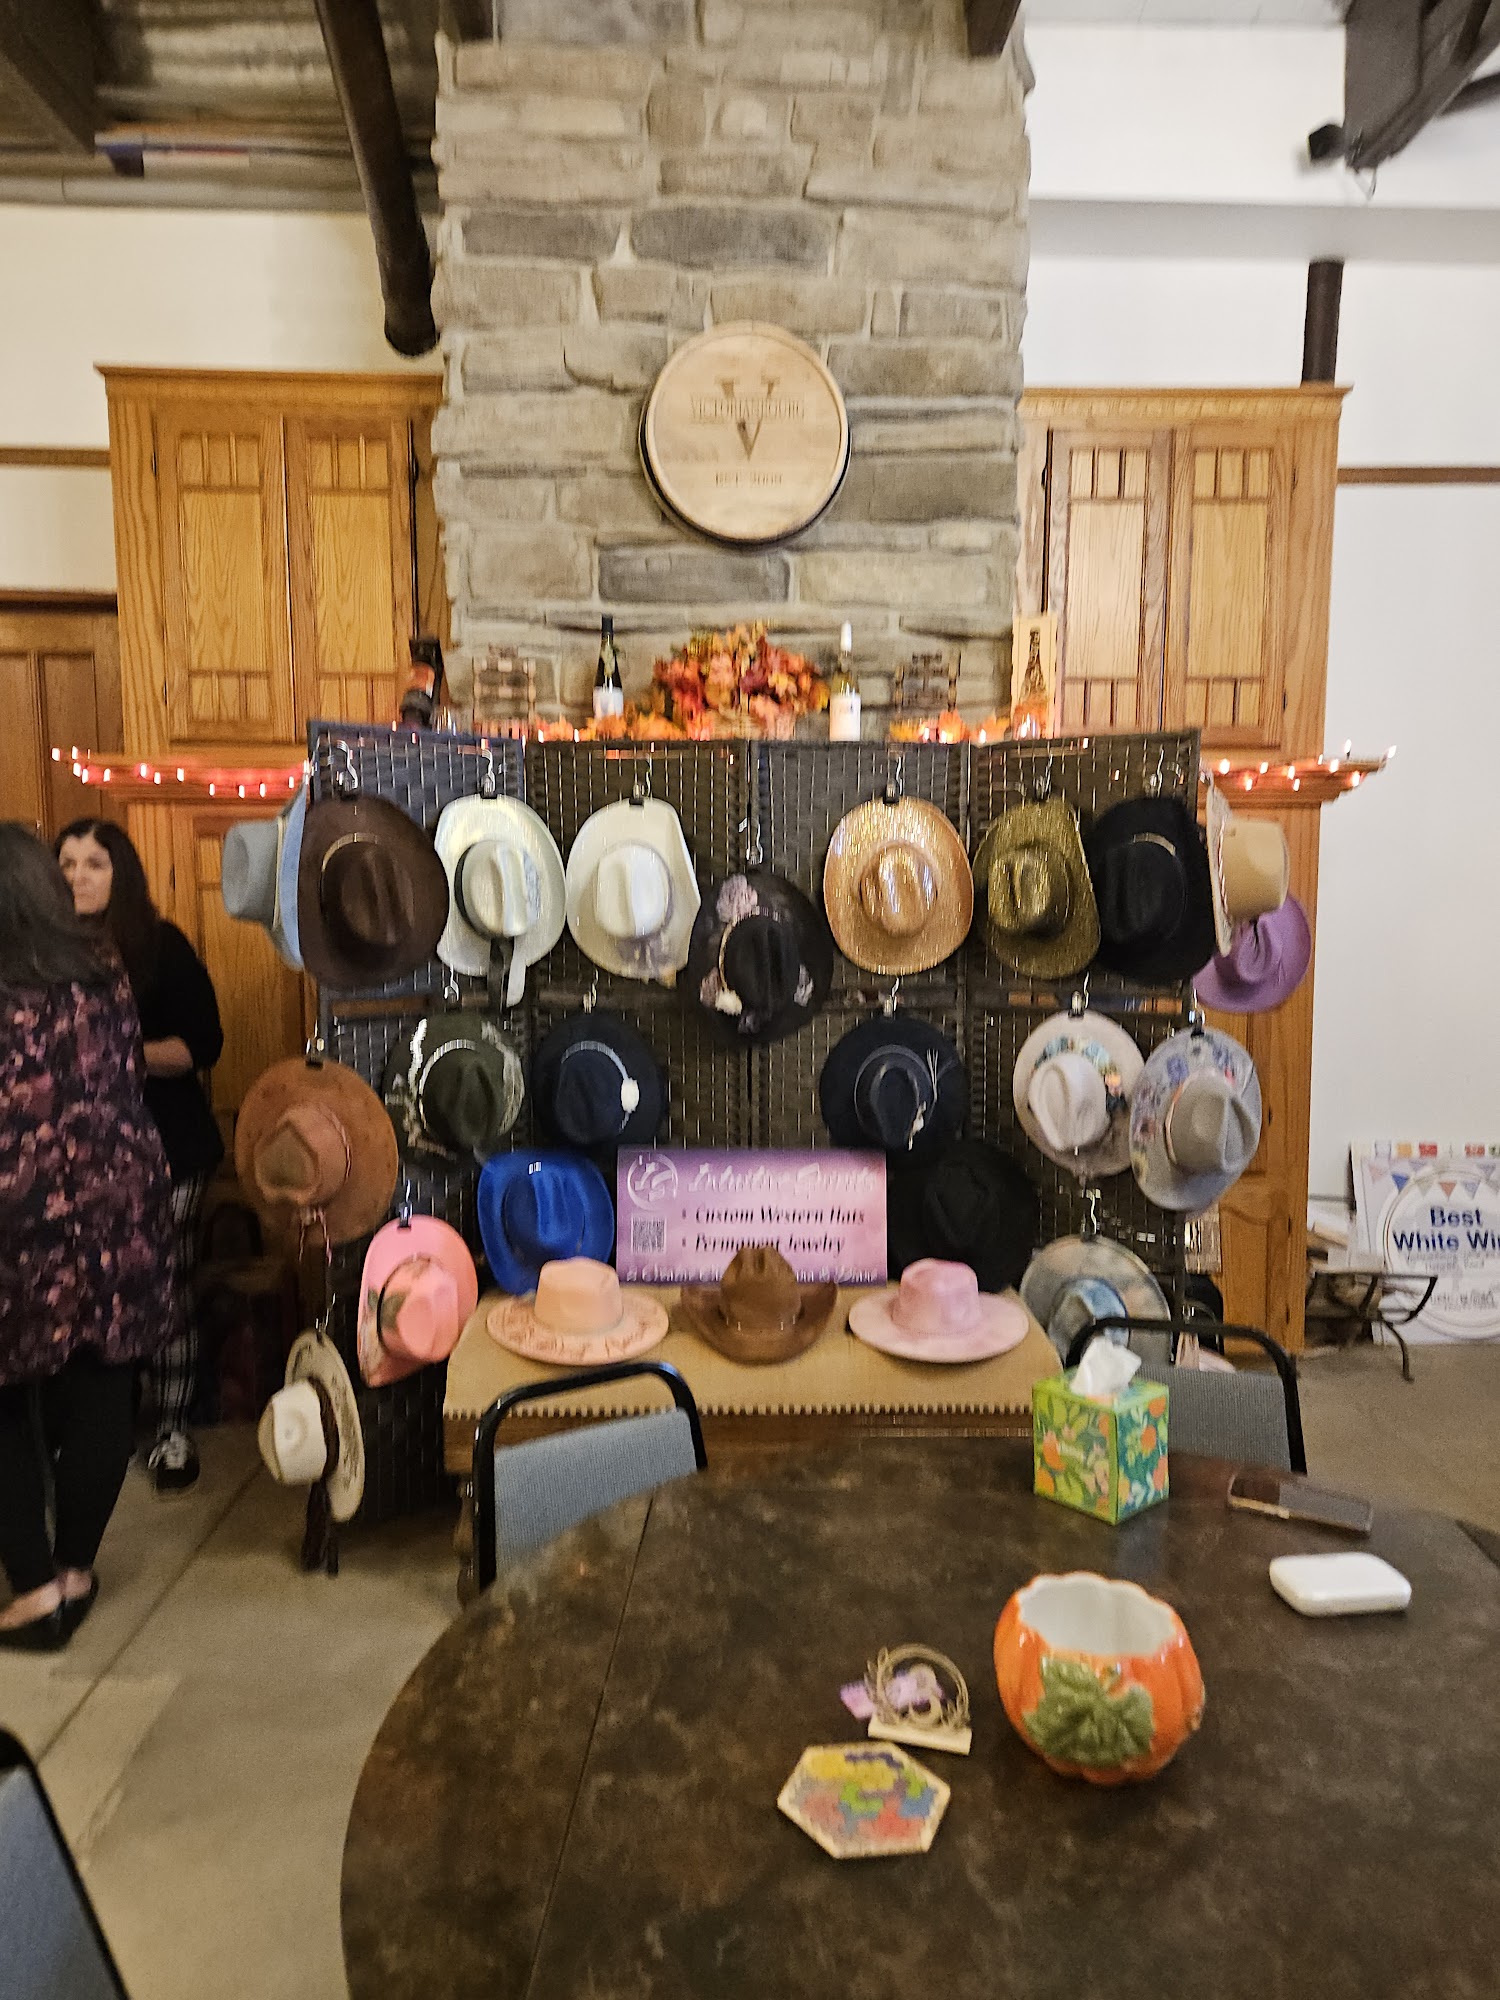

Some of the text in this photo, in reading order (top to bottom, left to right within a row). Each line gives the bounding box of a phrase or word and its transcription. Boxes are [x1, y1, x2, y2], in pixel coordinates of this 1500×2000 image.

[695, 1205, 865, 1225] Custom Western Hats
[1430, 1206, 1483, 1228] Best
[787, 1232, 845, 1258] Jewelry
[1393, 1230, 1460, 1251] White
